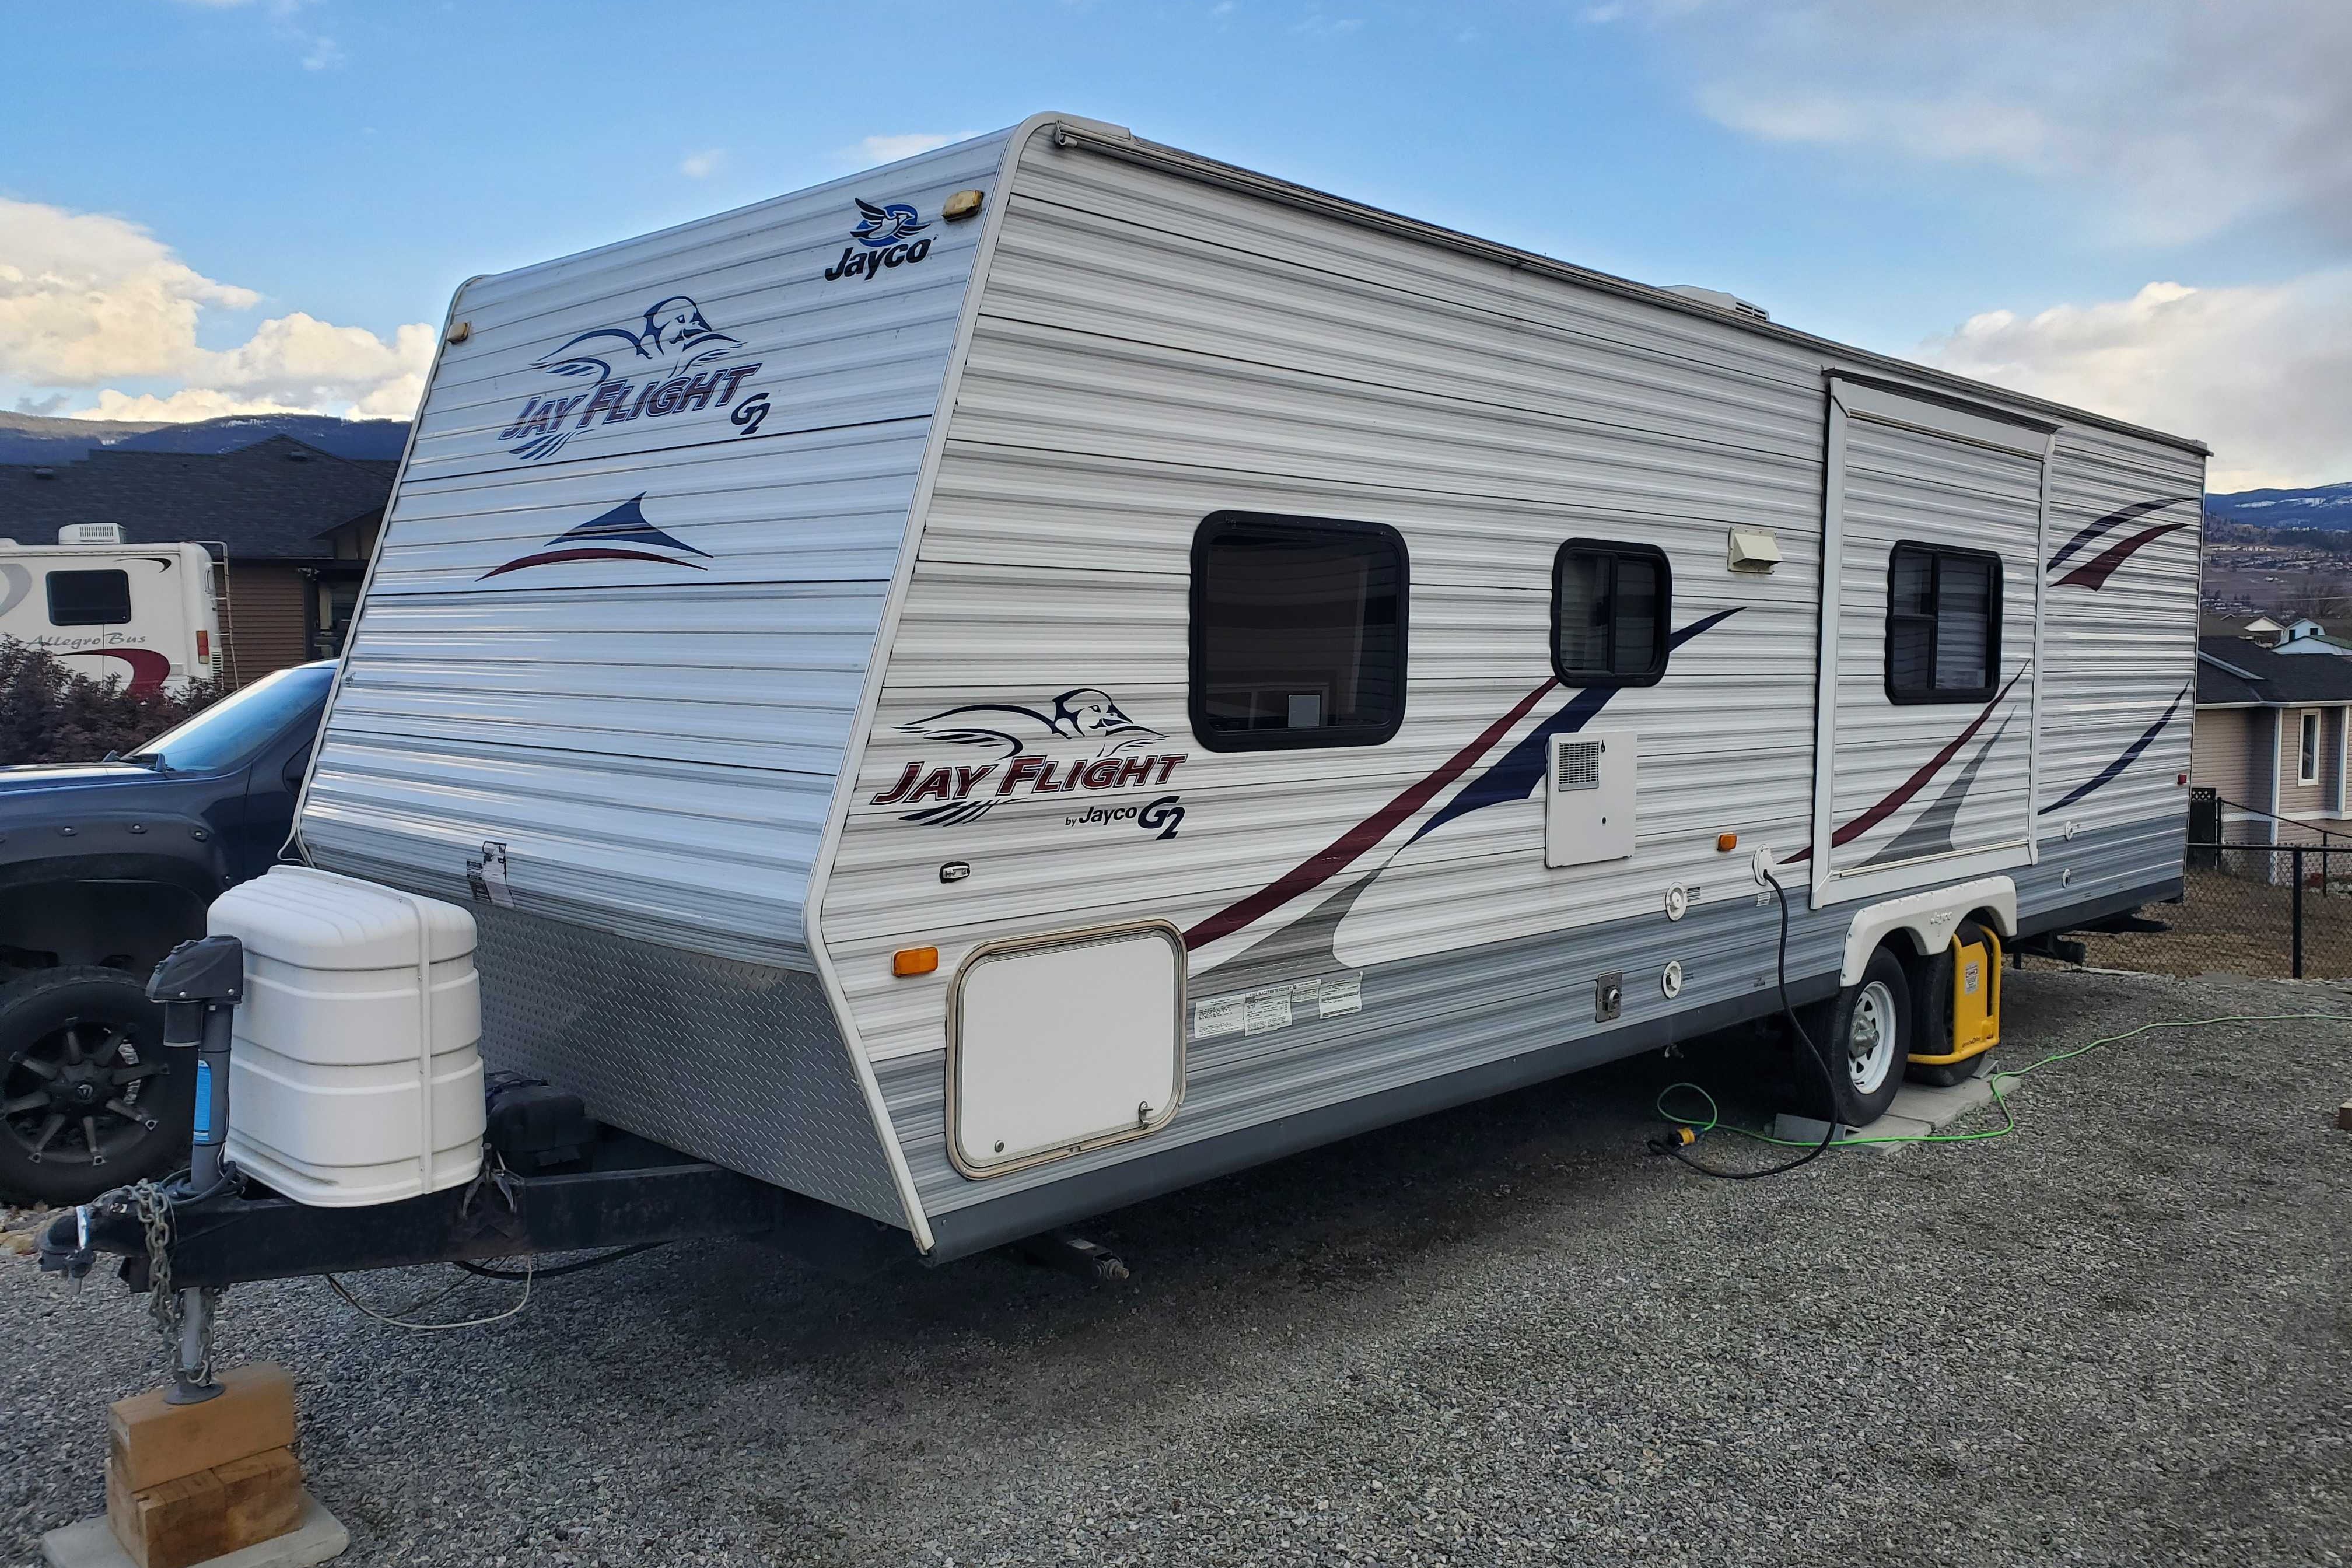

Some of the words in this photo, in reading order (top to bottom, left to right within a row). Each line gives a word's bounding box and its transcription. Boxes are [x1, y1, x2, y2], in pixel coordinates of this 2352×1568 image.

[824, 239, 932, 281] Jayco
[498, 394, 589, 440] JAY
[576, 362, 763, 429] FLIGHT
[730, 392, 771, 435] G2
[24, 634, 101, 649] Allegro
[104, 632, 145, 644] Bus
[869, 761, 1000, 806] JAY
[995, 753, 1189, 797] FLIGHT
[1065, 817, 1077, 827] by
[1078, 806, 1138, 826] Jayco
[1138, 795, 1186, 841] G2
